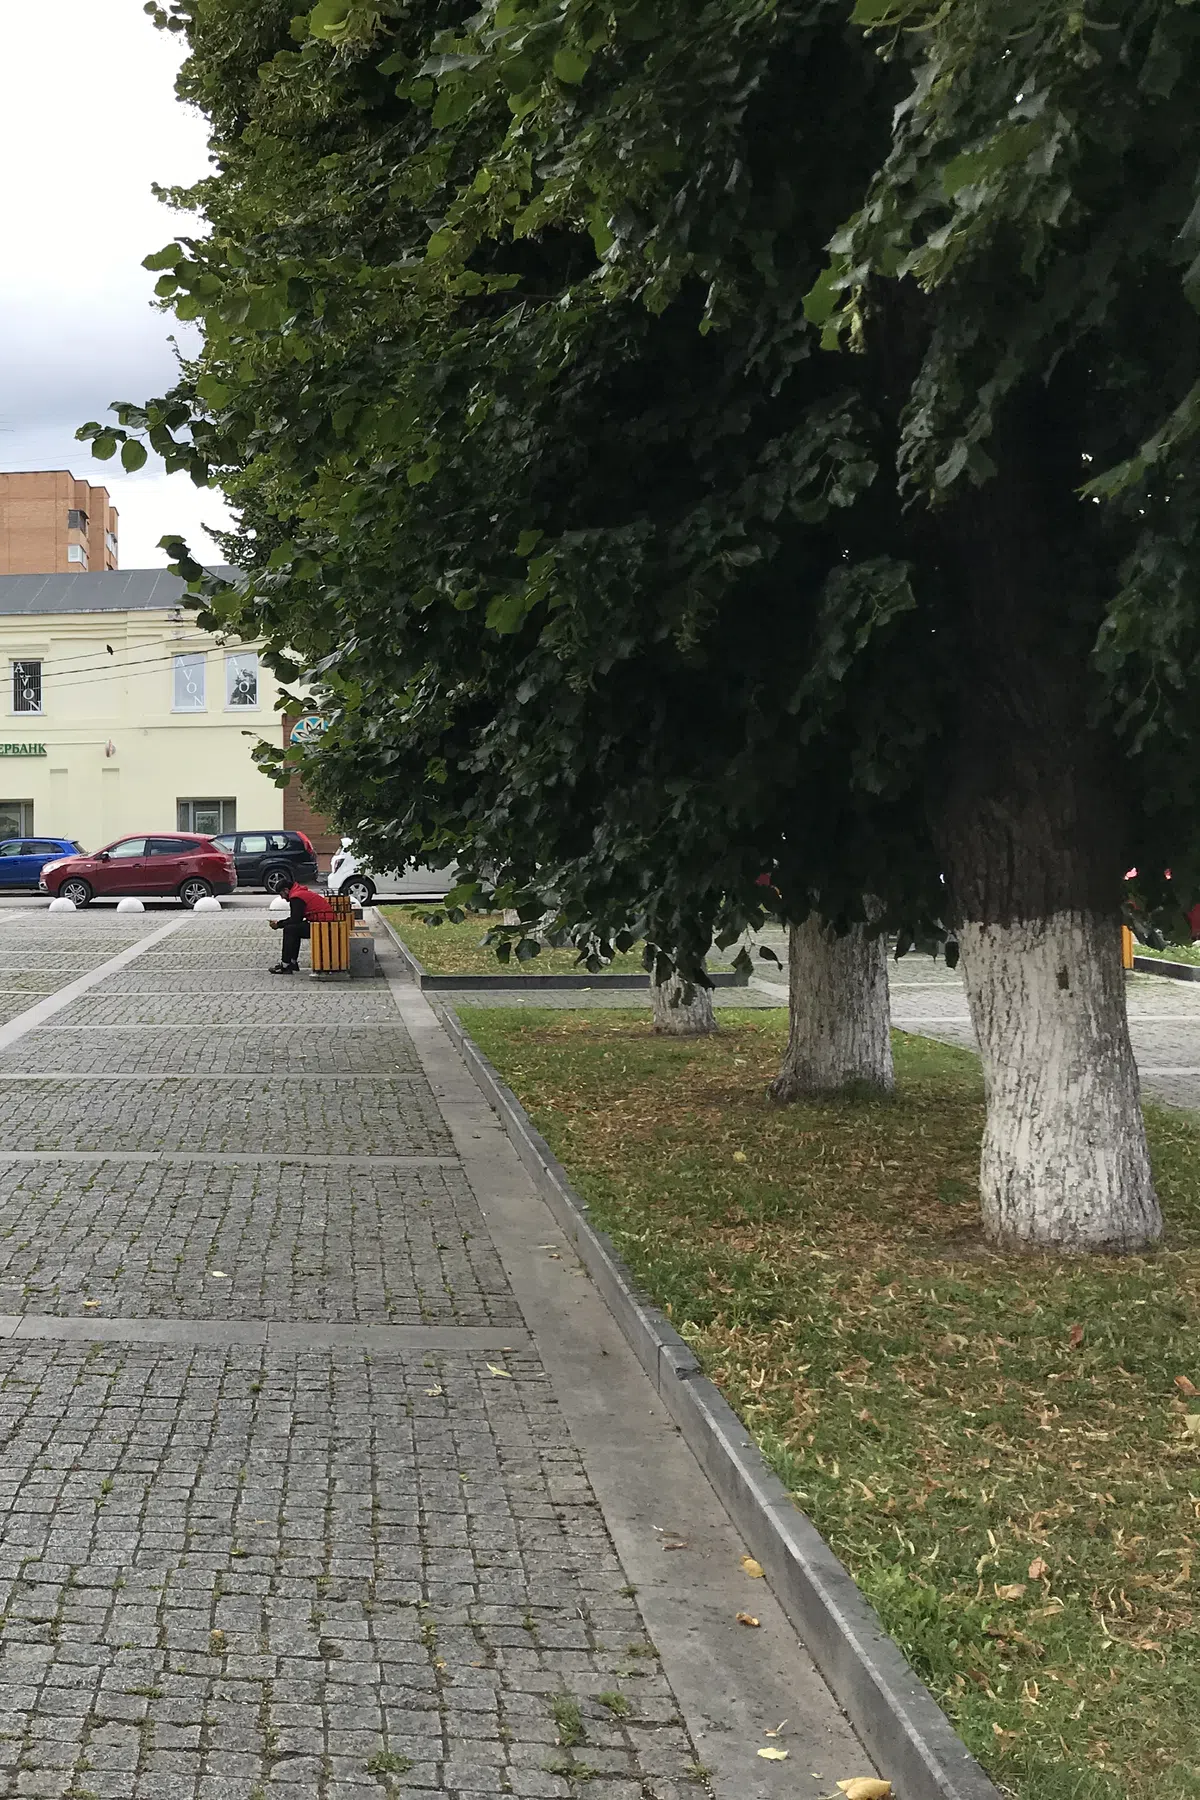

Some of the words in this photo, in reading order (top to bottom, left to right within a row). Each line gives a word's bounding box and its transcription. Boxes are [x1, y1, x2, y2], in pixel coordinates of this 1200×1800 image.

[14, 662, 42, 711] AVON
[175, 657, 204, 706] AVON
[228, 656, 256, 705] AVON
